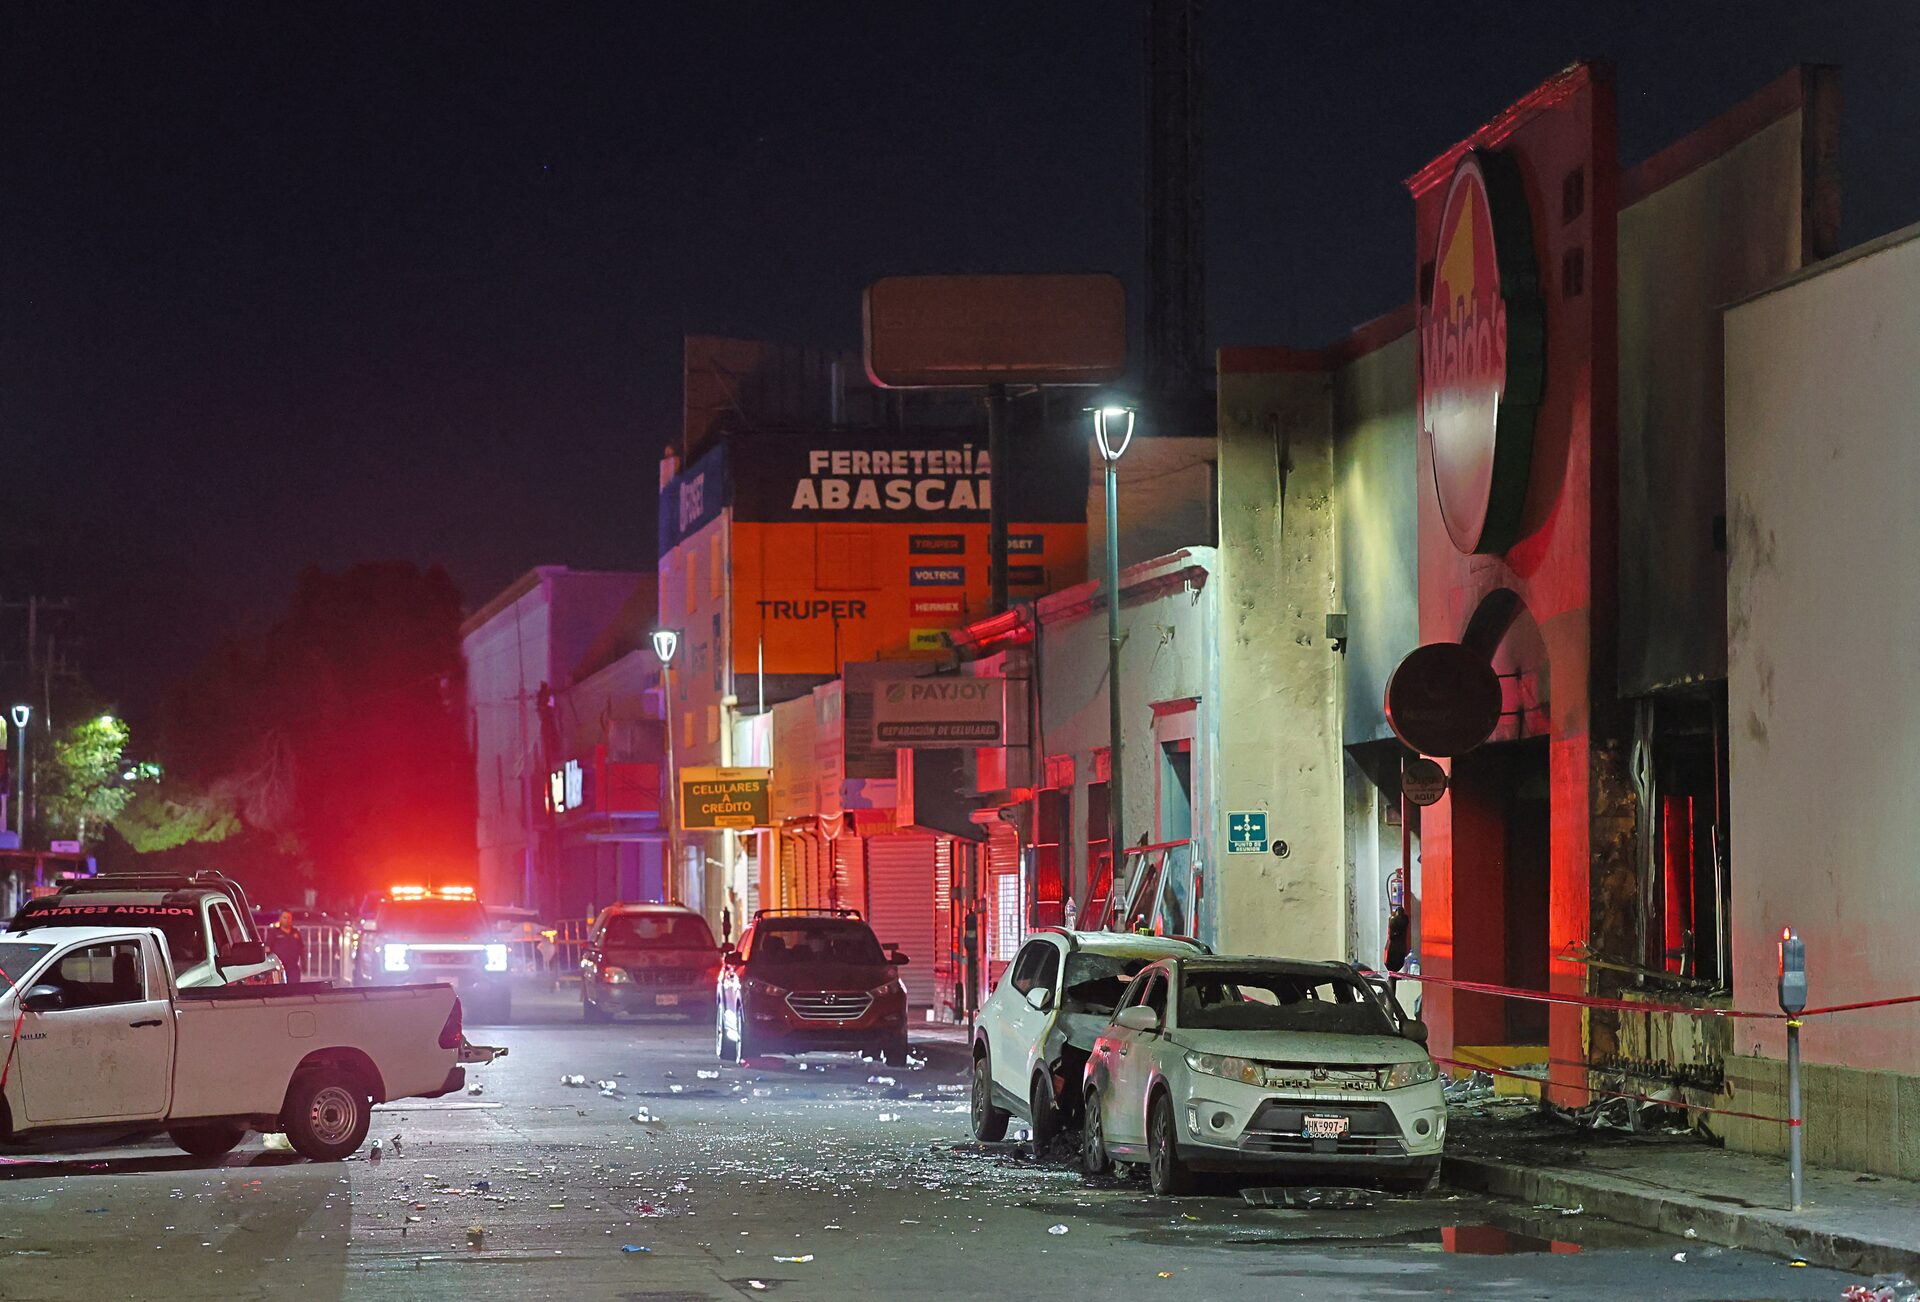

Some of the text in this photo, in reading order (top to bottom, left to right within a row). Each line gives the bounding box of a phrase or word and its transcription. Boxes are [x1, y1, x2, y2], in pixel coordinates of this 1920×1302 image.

[915, 539, 959, 549] TRUPER
[1007, 539, 1033, 549] OSET
[756, 600, 866, 620] TRUPER
[911, 683, 991, 700] PAYJOY
[692, 782, 760, 795] CELULARES
[722, 793, 731, 802] A
[702, 801, 752, 814] CREDITO
[20, 1032, 48, 1041] HILUX
